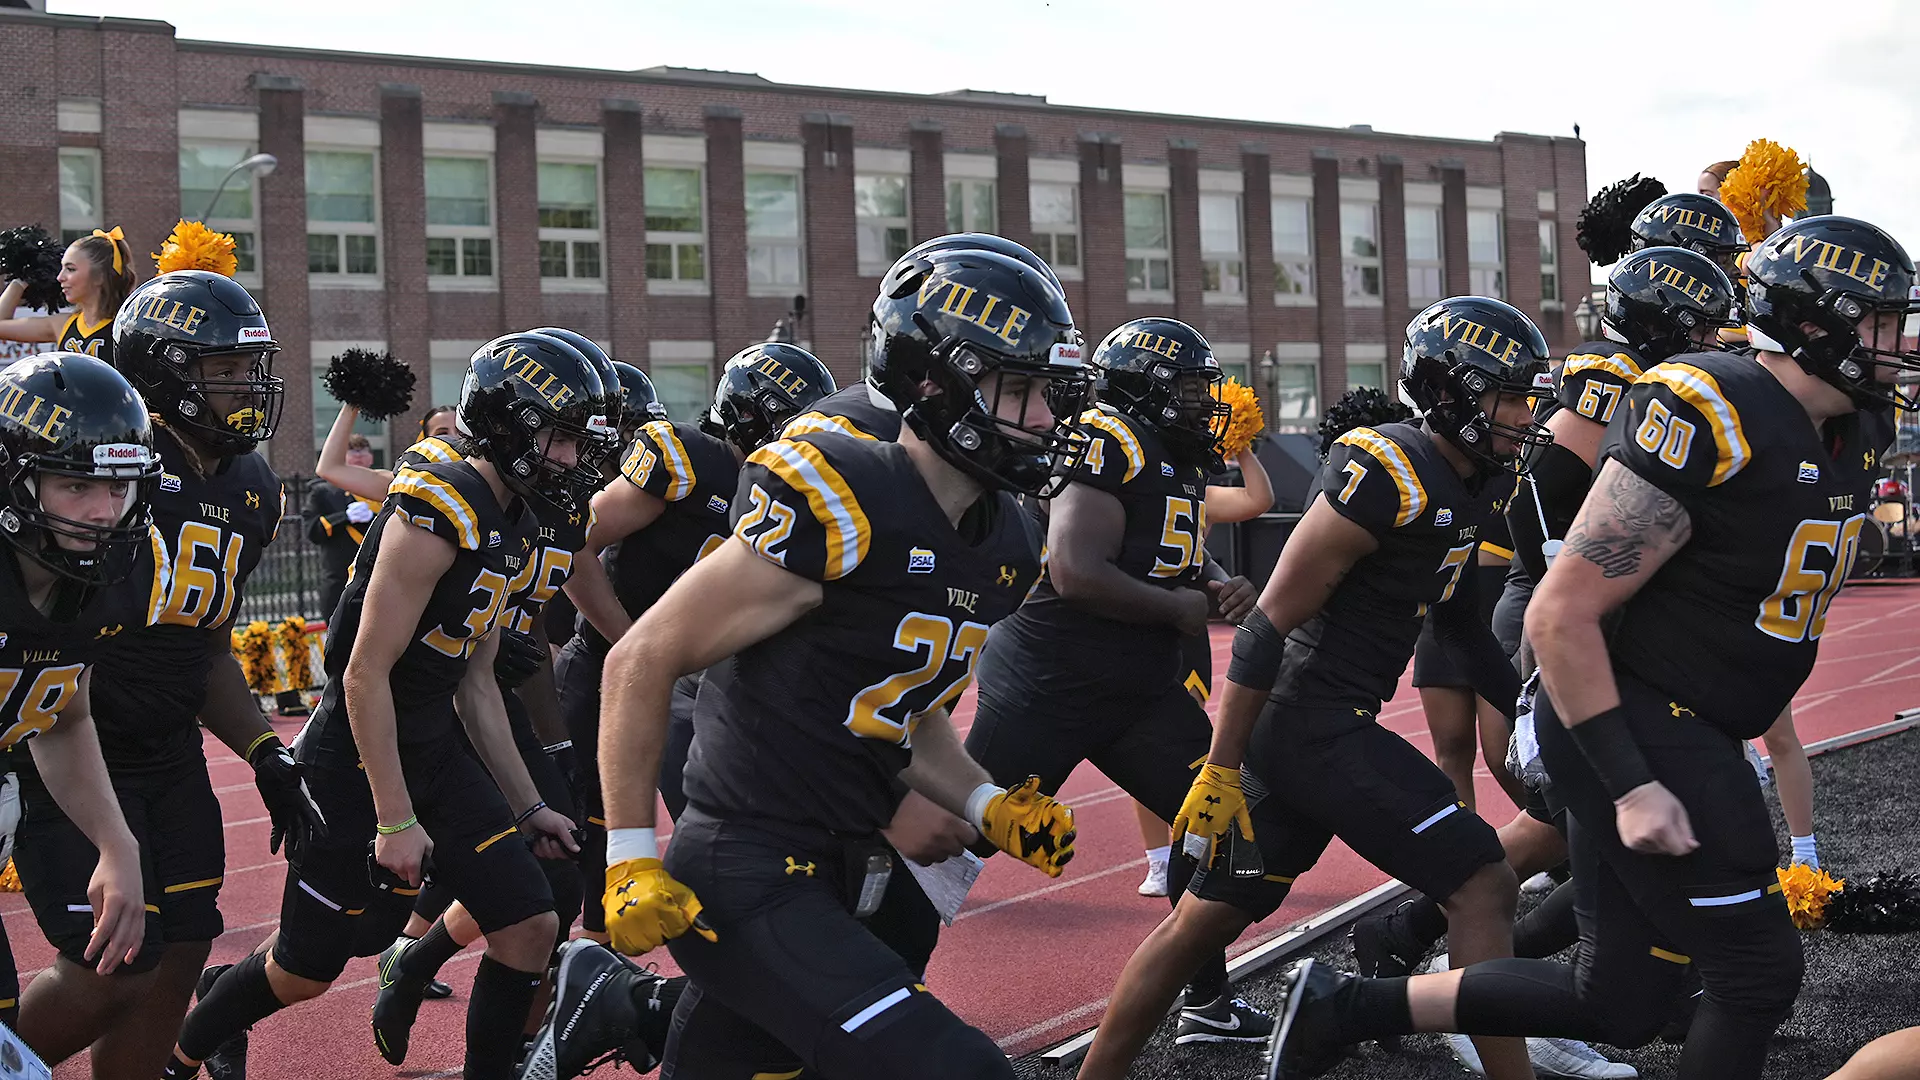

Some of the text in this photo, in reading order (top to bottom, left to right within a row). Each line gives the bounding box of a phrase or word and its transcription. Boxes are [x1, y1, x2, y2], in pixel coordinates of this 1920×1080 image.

[1660, 206, 1723, 238] VILLE
[1648, 258, 1714, 307] VILLE
[1795, 235, 1890, 293] VILLE
[134, 294, 206, 336] VILLE
[917, 273, 1032, 348] VILLE
[1118, 331, 1183, 361] VILLE
[1441, 316, 1523, 368] VILLE
[503, 347, 576, 412] VILLE
[751, 353, 809, 399] VILLE
[1575, 379, 1623, 423] 67
[108, 447, 138, 458] Riddell
[1634, 397, 1696, 470] 60
[162, 477, 180, 488] PSAC
[620, 438, 658, 489] 88
[1337, 458, 1368, 506] 7
[199, 502, 230, 524] VILLE
[733, 482, 797, 568] 22
[1828, 494, 1854, 513] VILLE
[156, 520, 244, 630] 61
[911, 555, 934, 566] PSAC
[1435, 541, 1476, 604] 7
[1754, 512, 1866, 643] 60
[947, 586, 979, 614] VILLE
[23, 649, 60, 665] VILLE
[842, 611, 990, 749] 22
